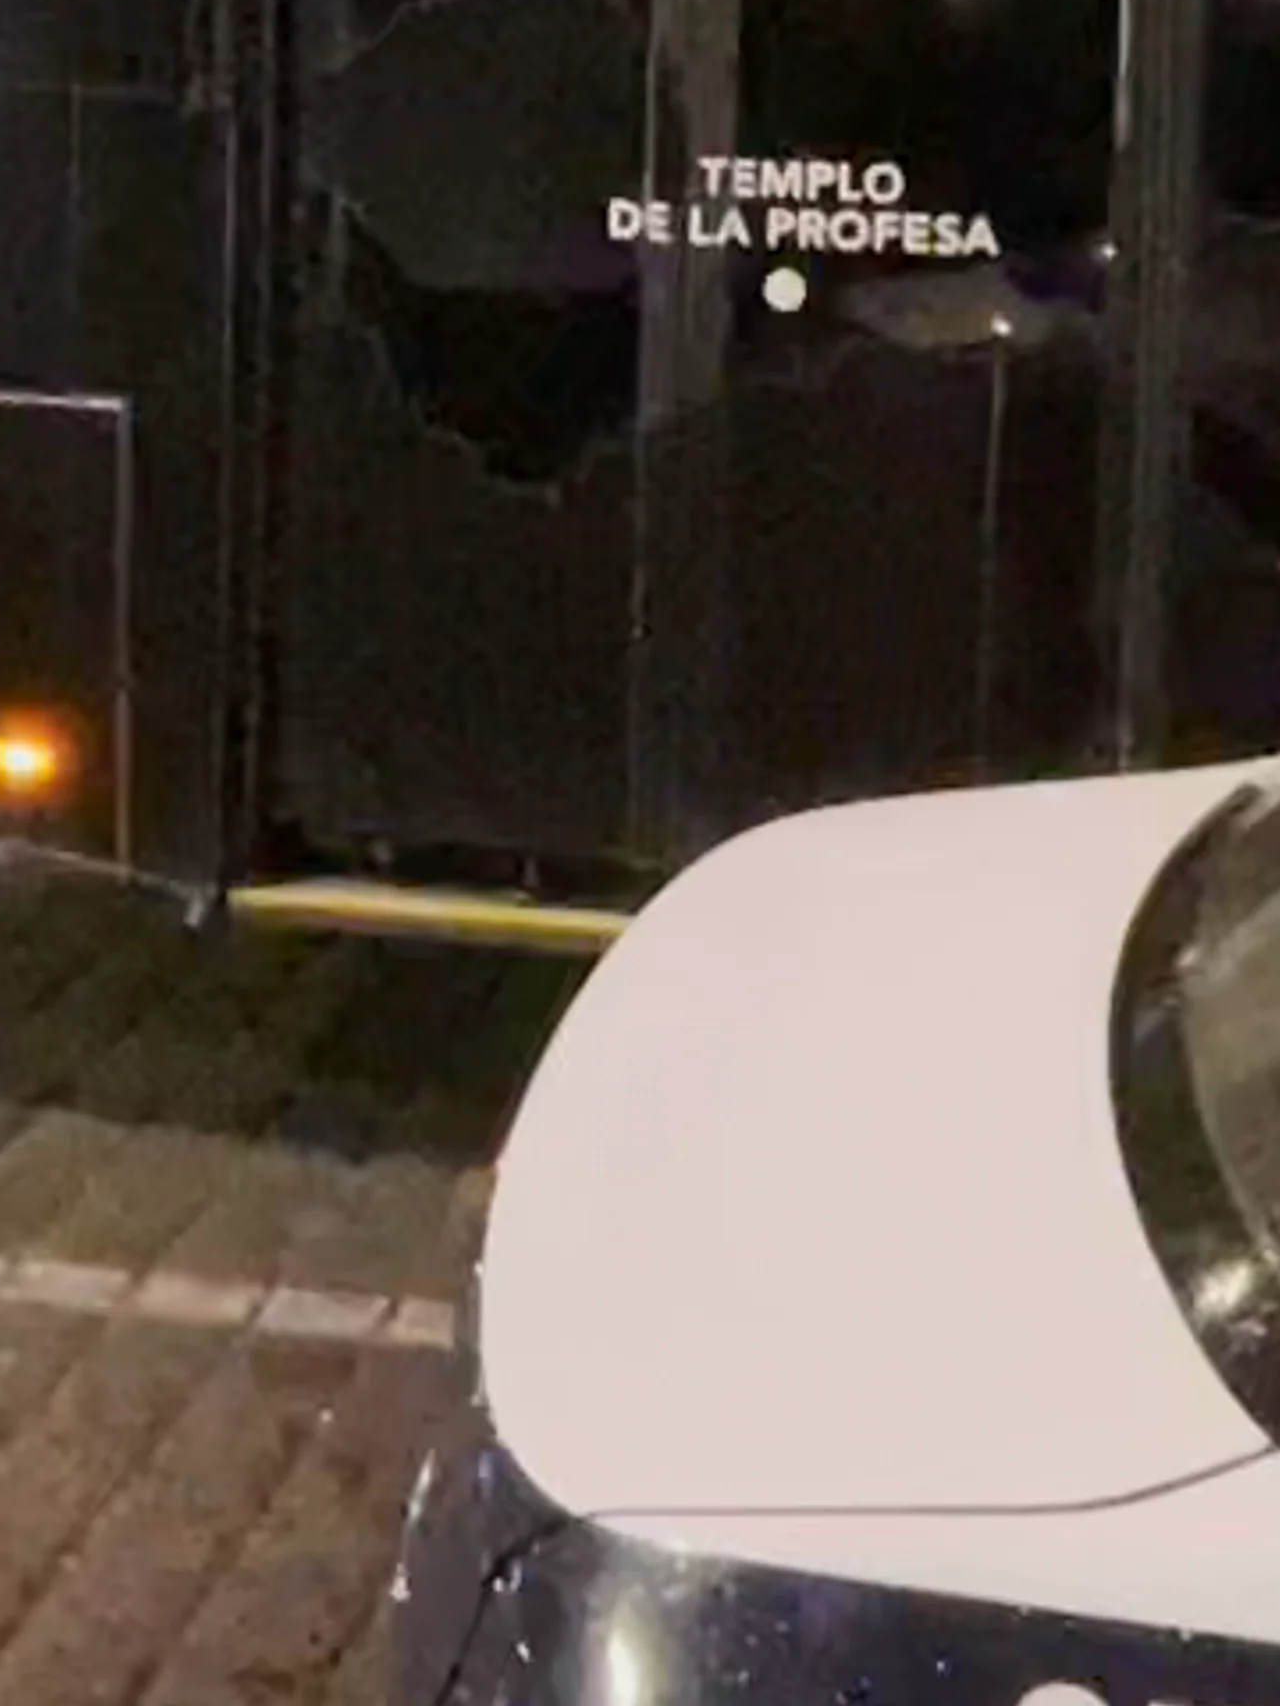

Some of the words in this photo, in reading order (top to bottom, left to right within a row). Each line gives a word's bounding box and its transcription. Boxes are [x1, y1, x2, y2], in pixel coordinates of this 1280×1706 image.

[697, 157, 906, 205] TEMPLO
[607, 197, 674, 244] DE
[687, 204, 752, 249] LA
[765, 206, 1002, 258] PROFESA
